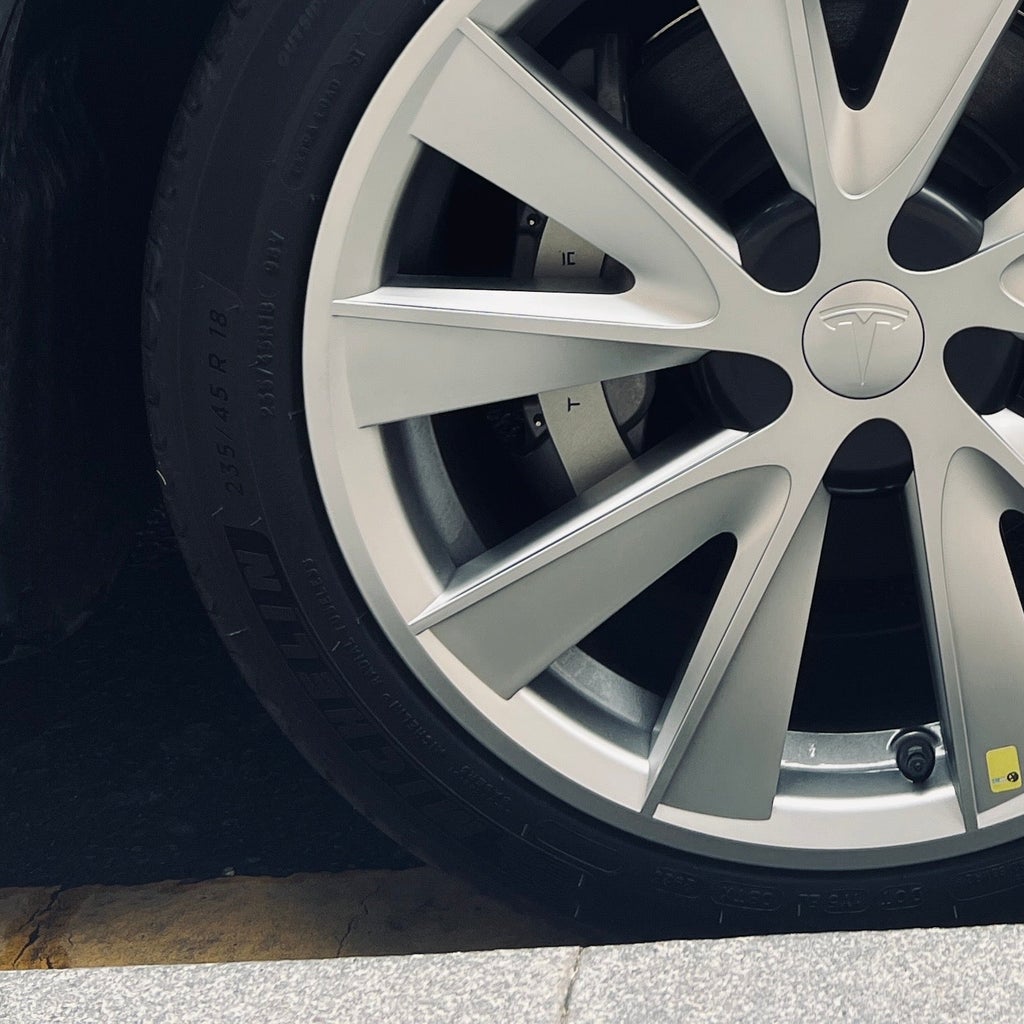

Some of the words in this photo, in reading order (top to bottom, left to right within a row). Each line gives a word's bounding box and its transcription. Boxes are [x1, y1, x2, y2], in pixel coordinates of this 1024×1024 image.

[209, 310, 227, 339] 18
[209, 353, 227, 373] R
[209, 384, 243, 497] 235/45
